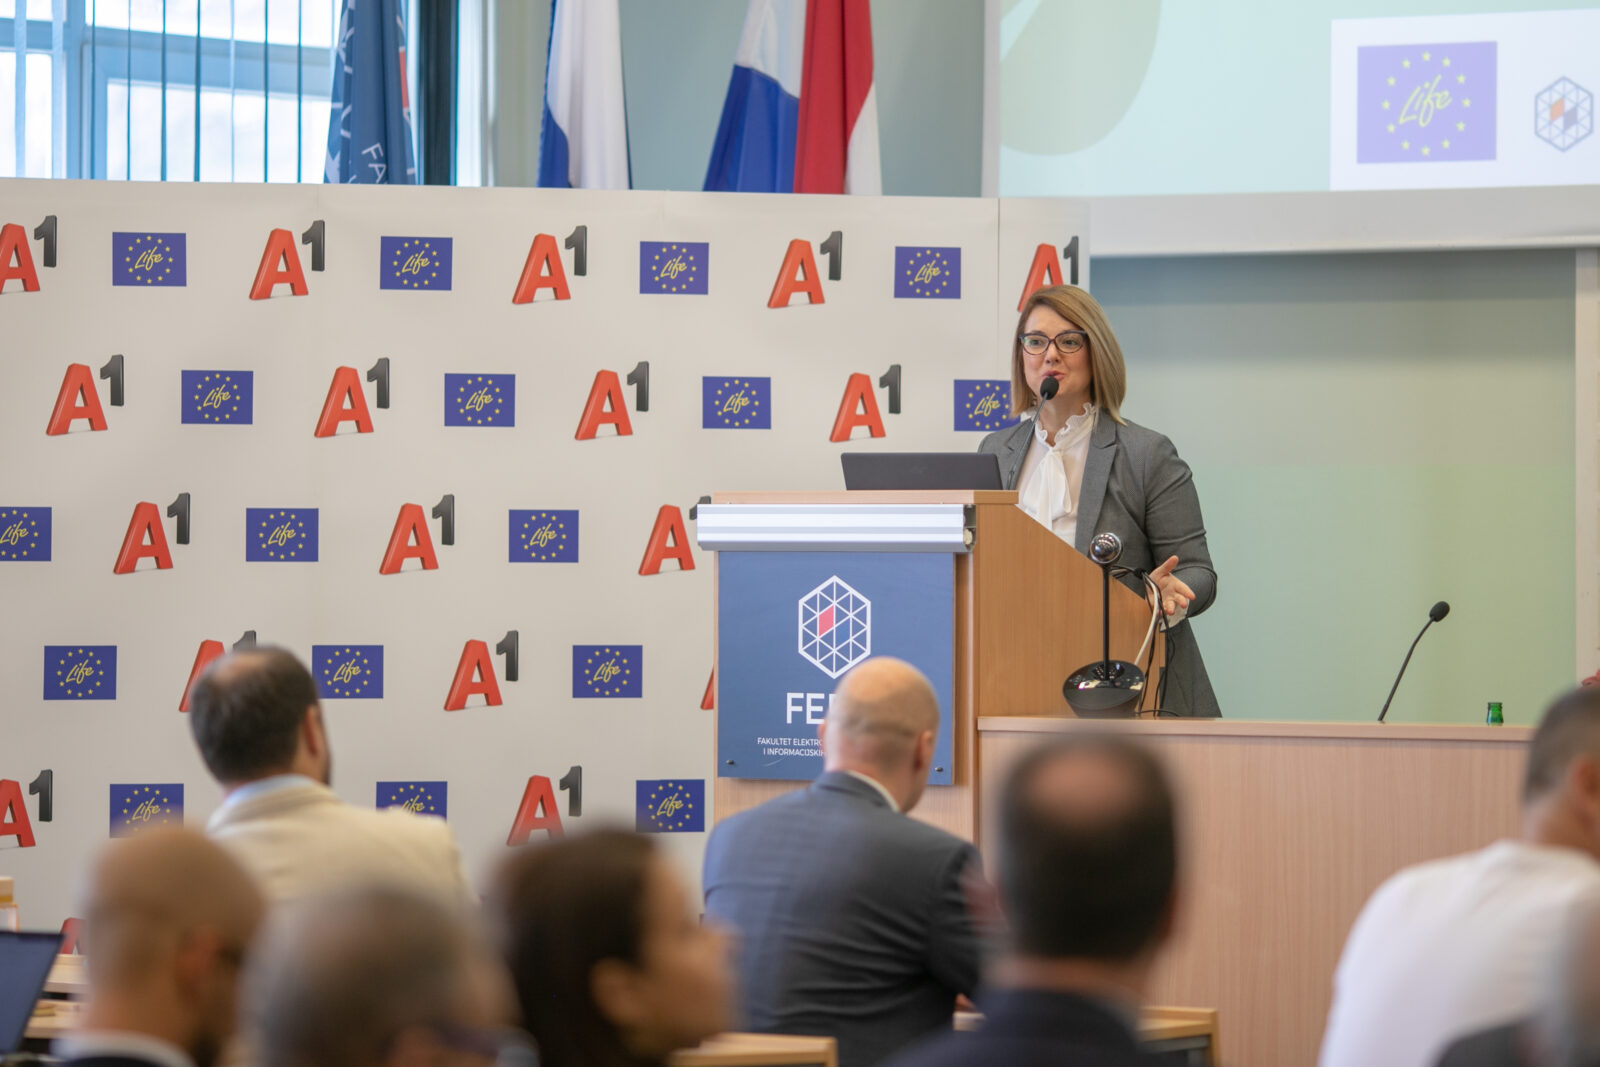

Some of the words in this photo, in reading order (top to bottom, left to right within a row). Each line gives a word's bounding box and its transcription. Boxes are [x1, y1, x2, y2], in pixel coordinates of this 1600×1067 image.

[1398, 73, 1452, 127] Life
[0, 215, 58, 295] A1
[134, 246, 163, 271] Life
[249, 220, 326, 300] A1
[401, 250, 430, 275] Life
[512, 225, 588, 304] A1
[660, 255, 687, 279] Life
[767, 230, 843, 308] A1
[913, 260, 941, 284] Life
[46, 354, 125, 436] A1
[202, 384, 231, 408] Life
[314, 357, 390, 438] A1
[465, 387, 494, 412] Life
[575, 361, 650, 440] A1
[722, 390, 750, 414] Life
[829, 364, 902, 442] A1
[974, 392, 1001, 417] Life
[0, 520, 29, 546] Life
[113, 492, 191, 574] A1
[267, 521, 296, 546] Life
[379, 494, 456, 575] A1
[529, 523, 557, 548] Life
[65, 659, 94, 684] Life
[332, 658, 361, 683] Life
[444, 630, 519, 712] A1
[593, 658, 621, 683] Life
[786, 692, 837, 724] FE
[757, 737, 792, 746] FAKULTET
[131, 797, 161, 822] Life
[656, 793, 684, 817] Life
